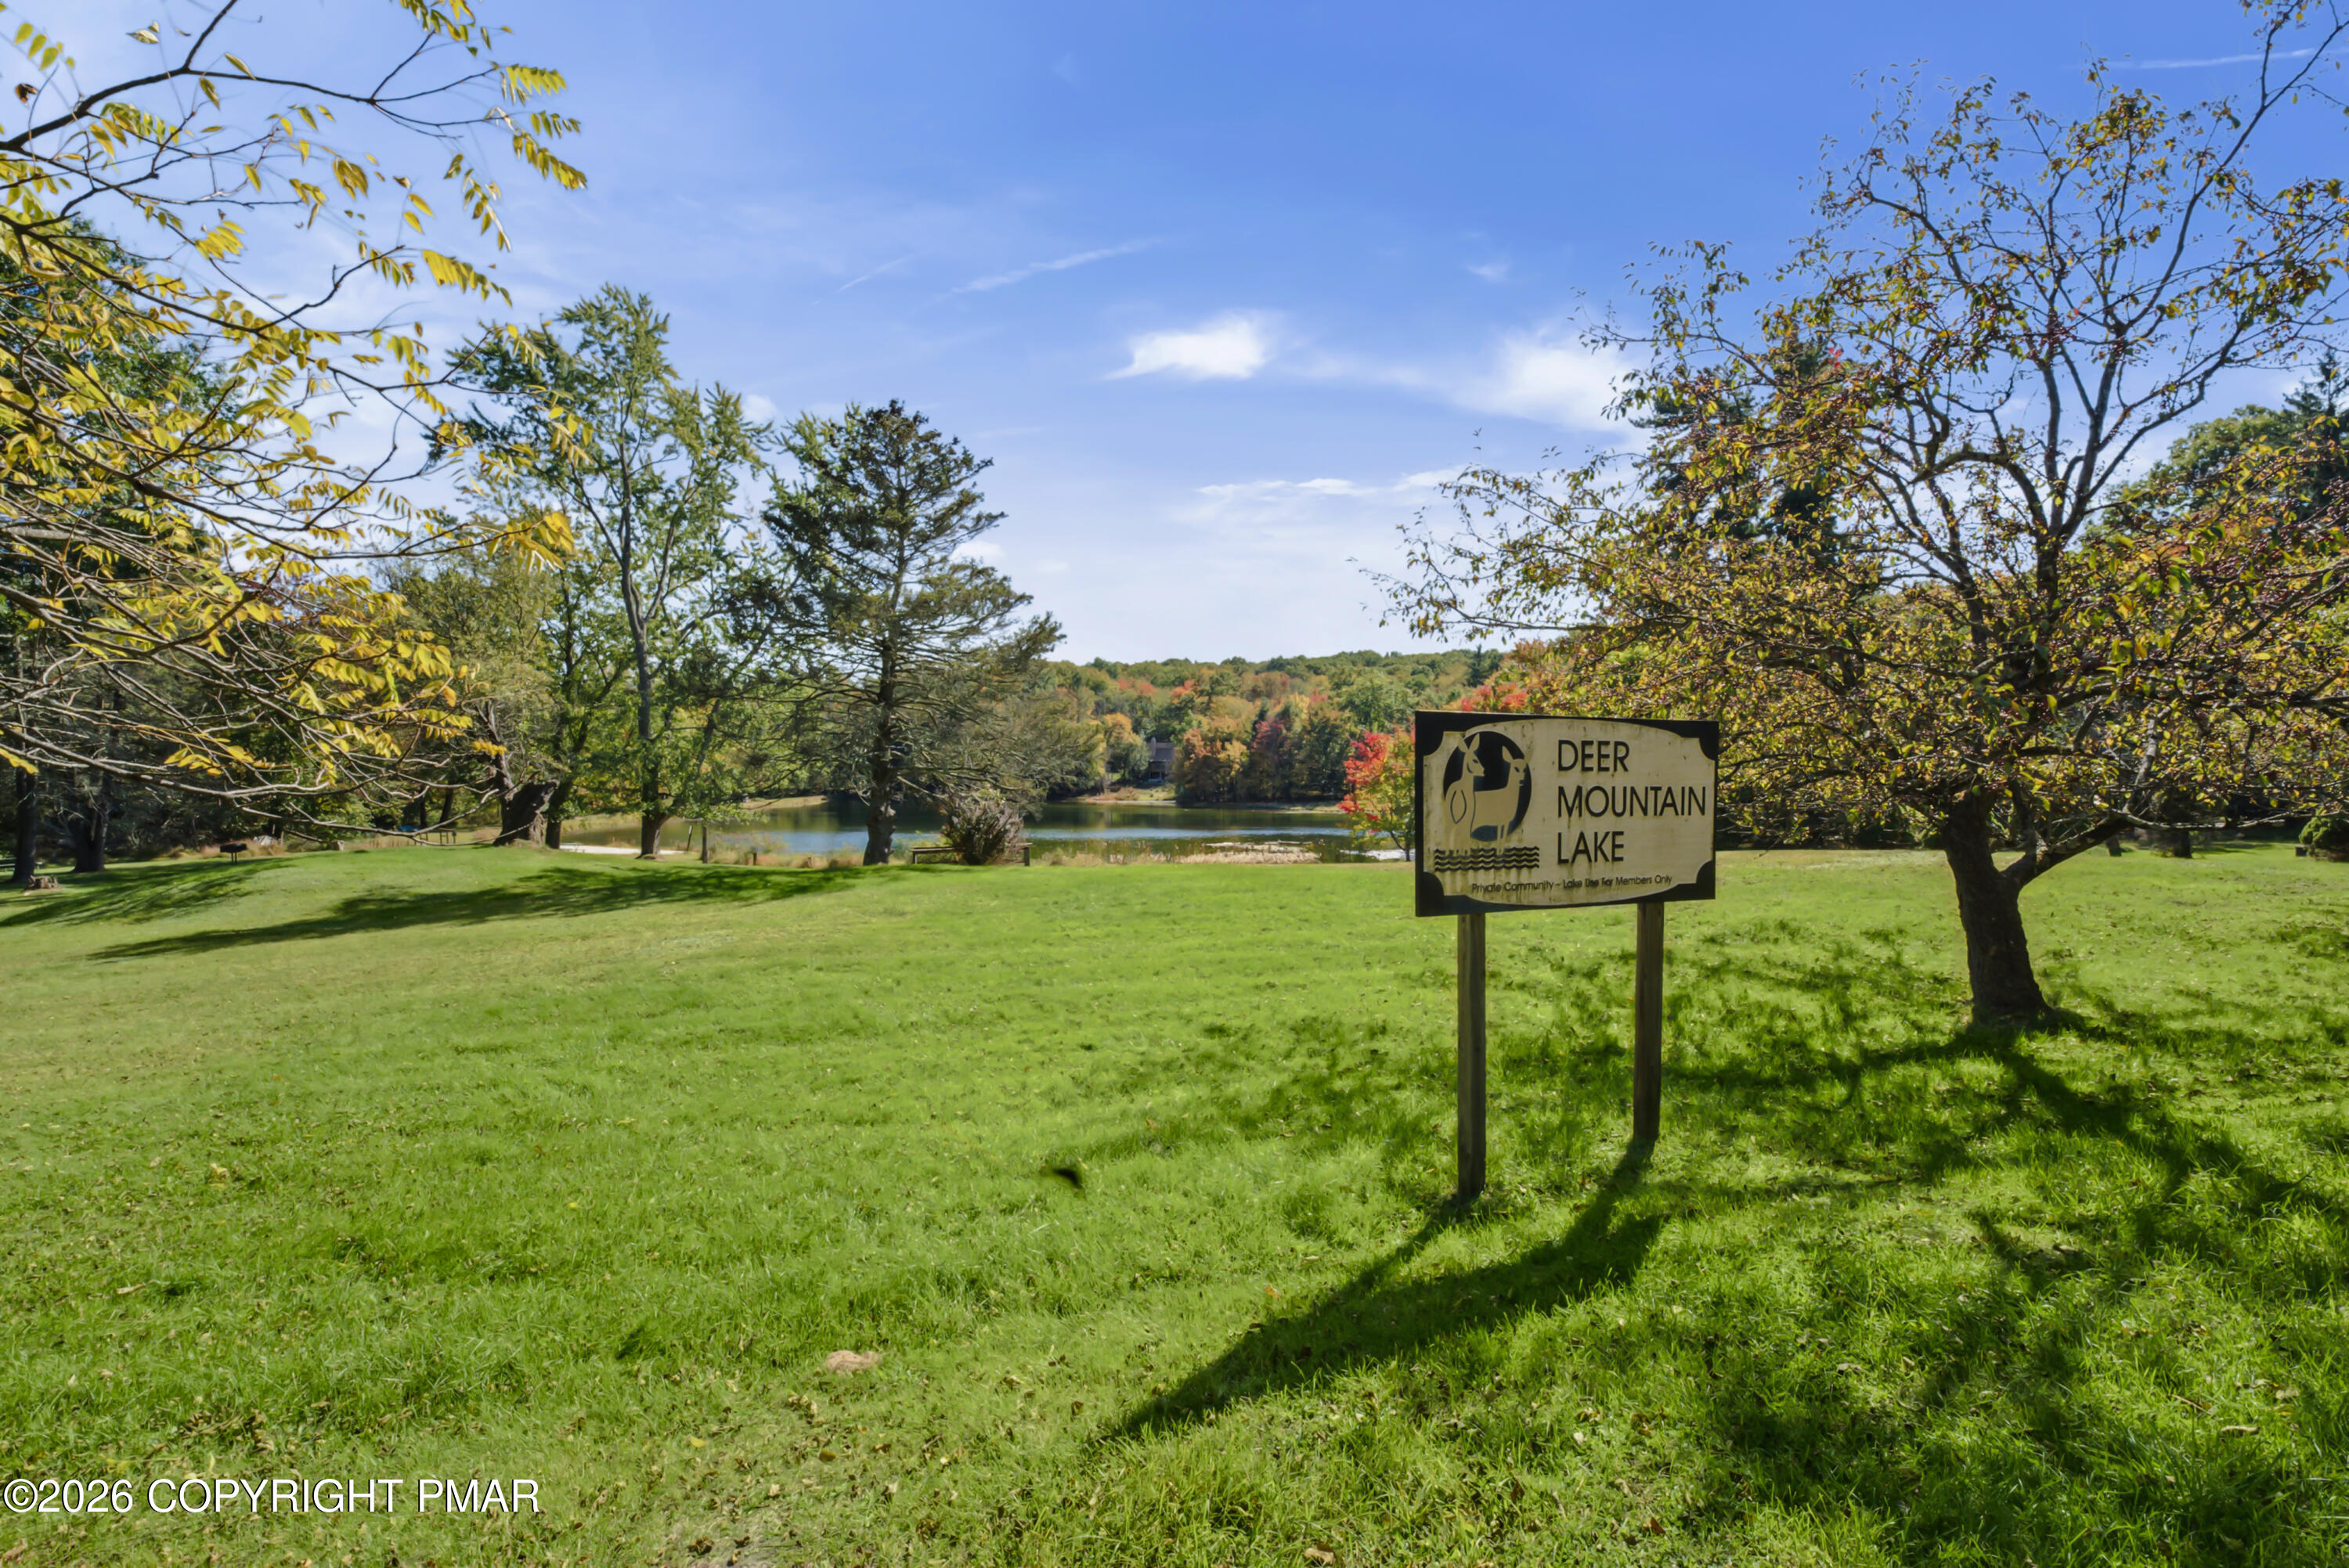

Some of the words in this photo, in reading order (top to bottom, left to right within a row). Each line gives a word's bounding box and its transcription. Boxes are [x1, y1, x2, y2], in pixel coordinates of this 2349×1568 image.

[1557, 739, 1630, 772] DEER
[1557, 785, 1706, 818] MOUNTAIN
[1557, 831, 1625, 864] LAKE
[1472, 883, 1501, 893] Private
[1505, 881, 1553, 892] Community
[1563, 879, 1582, 889] Lake
[1585, 879, 1599, 888] Use
[1601, 878, 1613, 887] For
[1615, 876, 1652, 886] Members
[1654, 874, 1672, 885] Only
